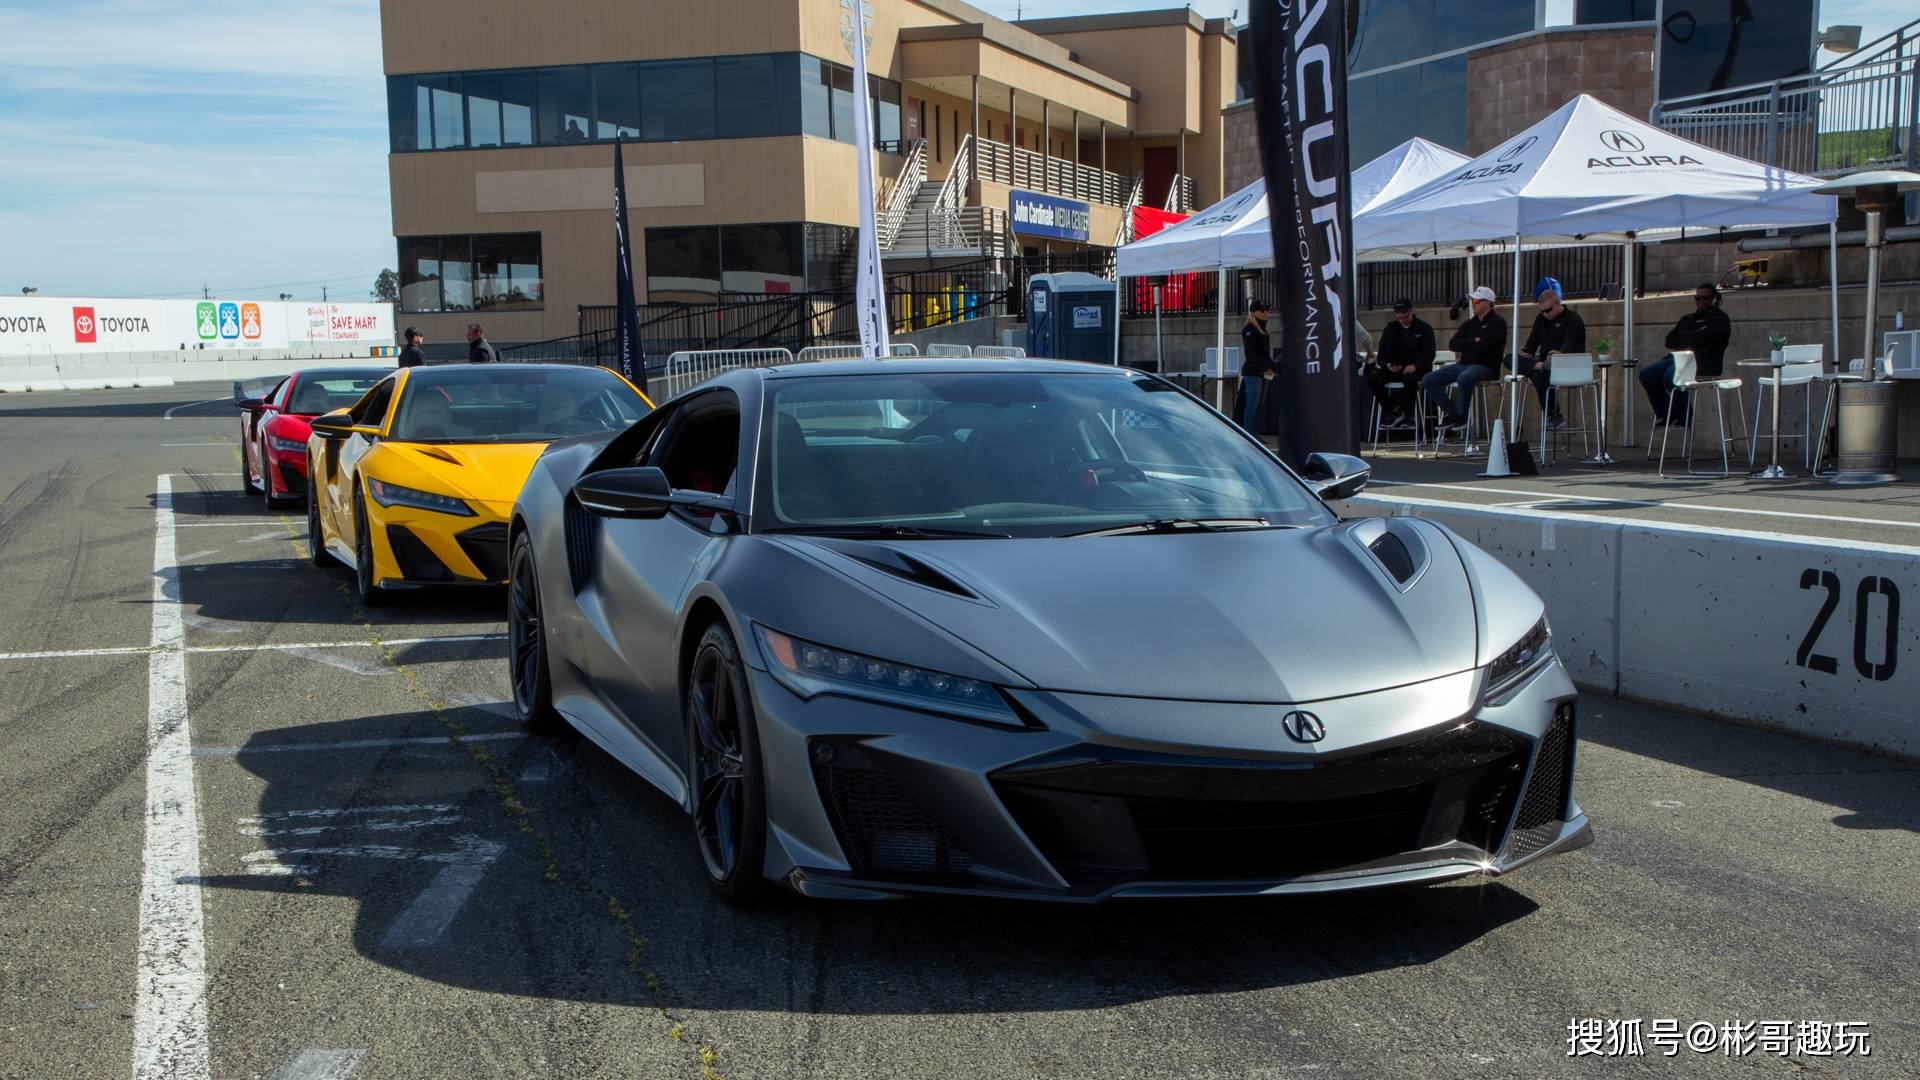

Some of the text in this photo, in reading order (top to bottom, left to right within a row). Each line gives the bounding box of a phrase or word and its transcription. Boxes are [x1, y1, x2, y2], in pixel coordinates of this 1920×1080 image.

[1586, 155, 1704, 168] ACURA
[1451, 162, 1523, 182] ACURA
[1014, 200, 1090, 232] John Cardinale MEDIA CENTER
[0, 317, 46, 333] OYOTA
[100, 317, 149, 332] TOYOTA
[331, 316, 352, 329] SAVE
[354, 316, 376, 329] MART
[1796, 568, 1900, 682] 20
